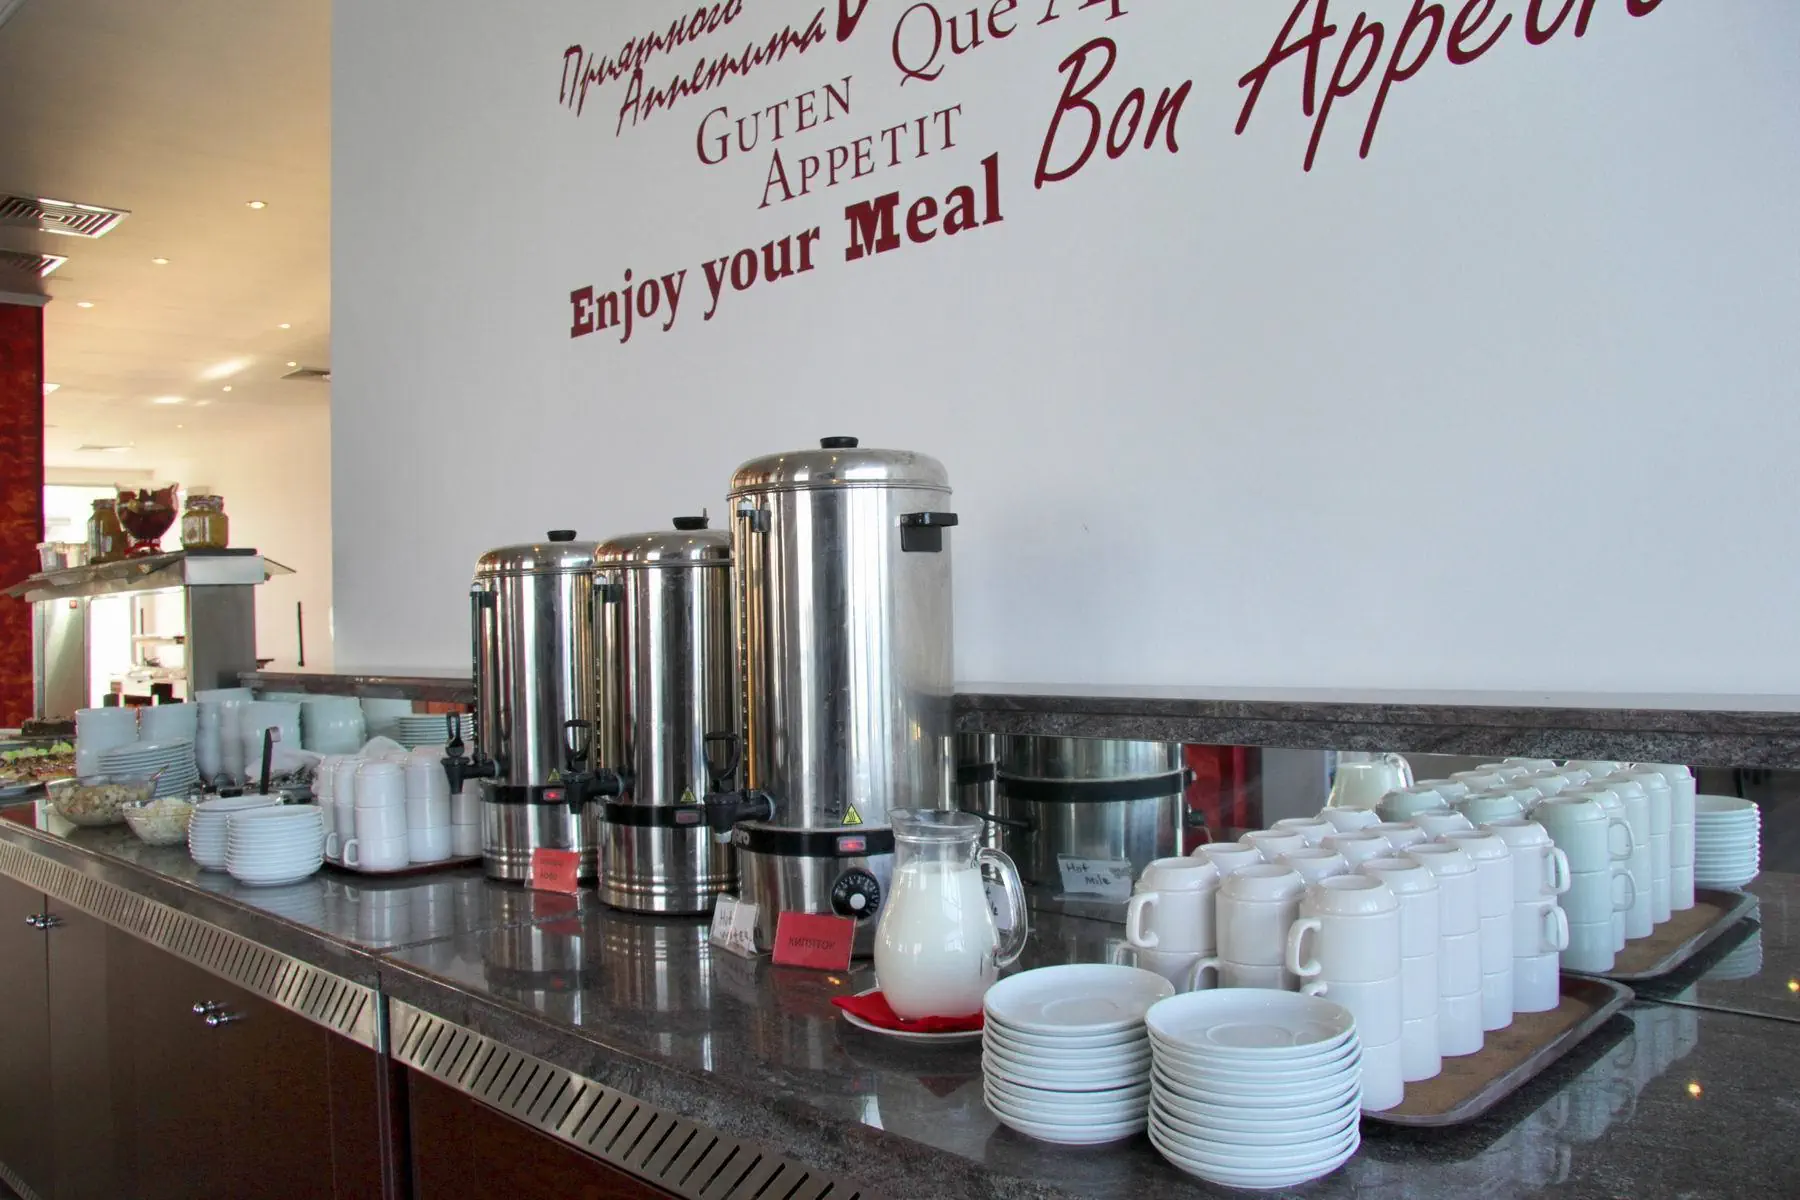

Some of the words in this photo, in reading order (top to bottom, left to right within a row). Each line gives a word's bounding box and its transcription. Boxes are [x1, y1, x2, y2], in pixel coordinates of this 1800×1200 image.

[891, 0, 1018, 87] Que
[1034, 36, 1193, 190] Bon
[1234, 0, 1663, 172] Appe
[696, 75, 853, 165] GUTEN
[757, 104, 962, 209] APPETIT
[570, 268, 688, 344] Enjoy
[701, 226, 820, 321] your
[844, 151, 1004, 262] Meal
